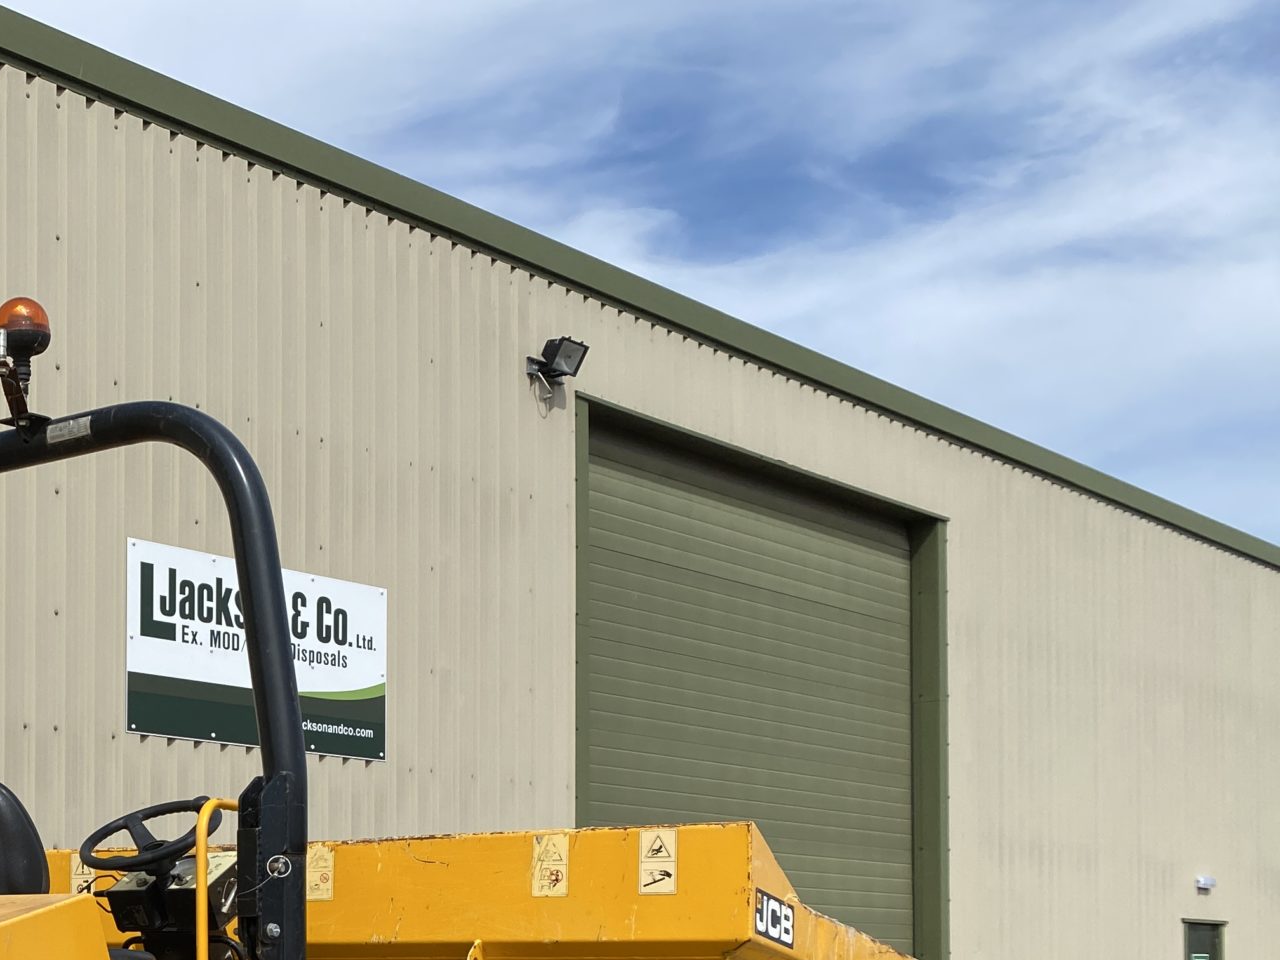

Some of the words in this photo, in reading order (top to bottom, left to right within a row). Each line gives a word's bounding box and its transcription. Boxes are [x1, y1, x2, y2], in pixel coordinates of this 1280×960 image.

[181, 625, 203, 646] Ex.
[292, 591, 309, 639] &
[317, 596, 353, 647] Co.
[356, 634, 377, 651] Ltd.
[301, 719, 374, 738] cksonandco.com
[756, 894, 794, 945] JCB
